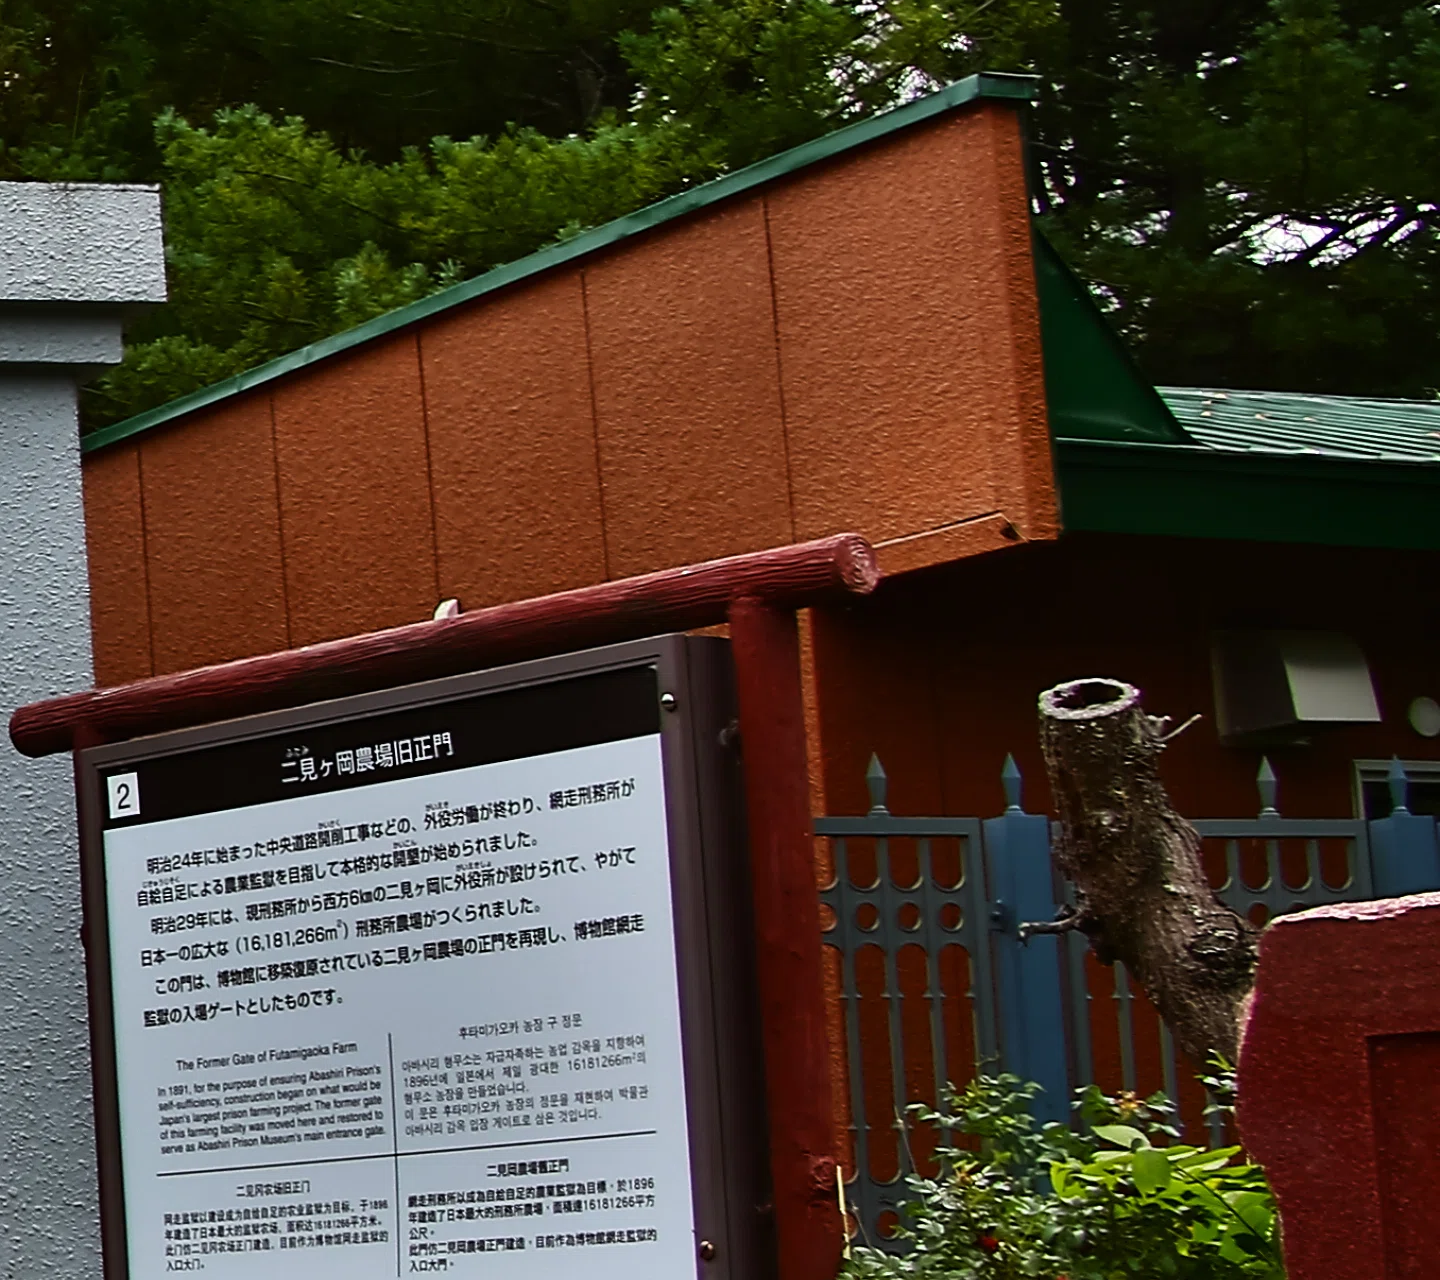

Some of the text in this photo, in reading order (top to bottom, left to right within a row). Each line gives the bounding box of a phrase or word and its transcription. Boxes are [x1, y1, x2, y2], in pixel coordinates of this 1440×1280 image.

[117, 783, 131, 809] 2
[459, 1013, 582, 1039] 후타미가오카 농장 구 정문
[176, 1042, 357, 1071] The Former Gate of Futamigaoka Farm
[158, 1065, 381, 1096] In 1891, for the purpose of ensuring Abashiri Prison's
[159, 1080, 381, 1111] self-sufficiency, construction began on what would be
[160, 1096, 382, 1126] Japan's largest prison farming project. The former gate
[160, 1110, 383, 1140] of this farming facility was moved here and restored to
[161, 1125, 386, 1154] serve as Abashiri Prison Museum's main entrance gate.
